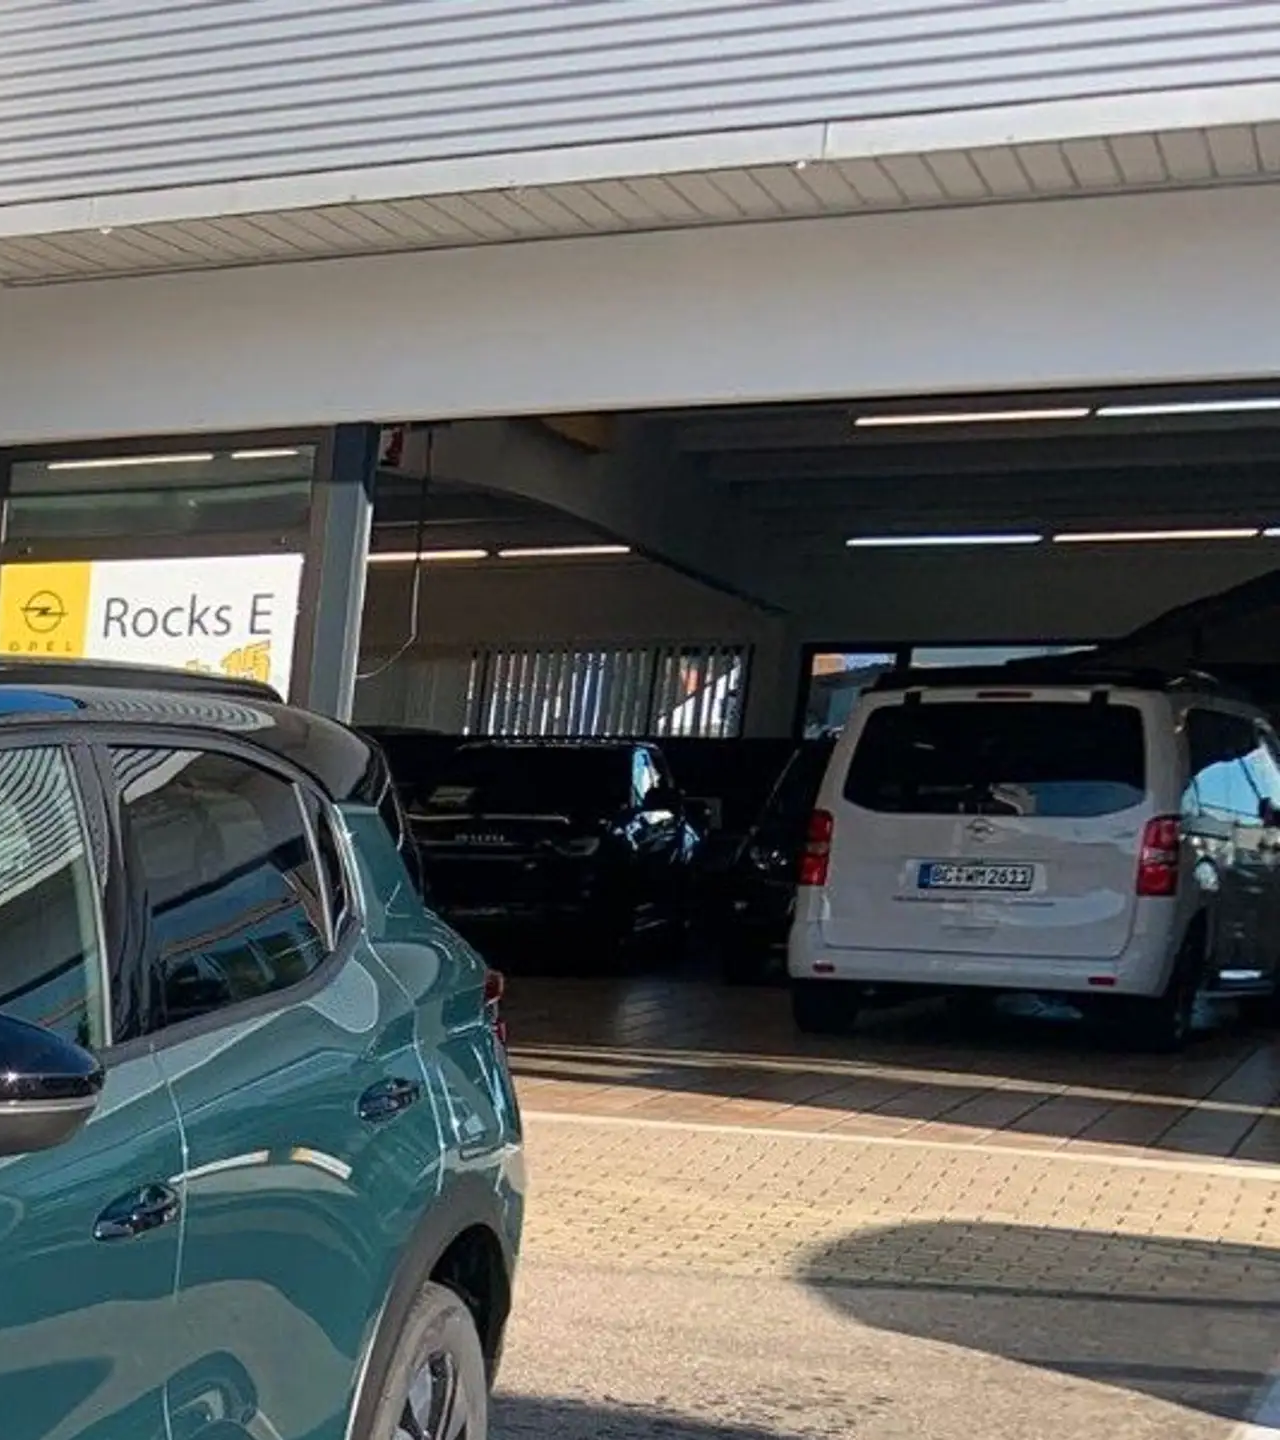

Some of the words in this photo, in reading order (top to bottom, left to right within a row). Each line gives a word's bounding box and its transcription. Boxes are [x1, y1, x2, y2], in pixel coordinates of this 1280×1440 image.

[101, 592, 233, 639] Rocks
[248, 592, 276, 636] E
[8, 639, 74, 653] OPEL
